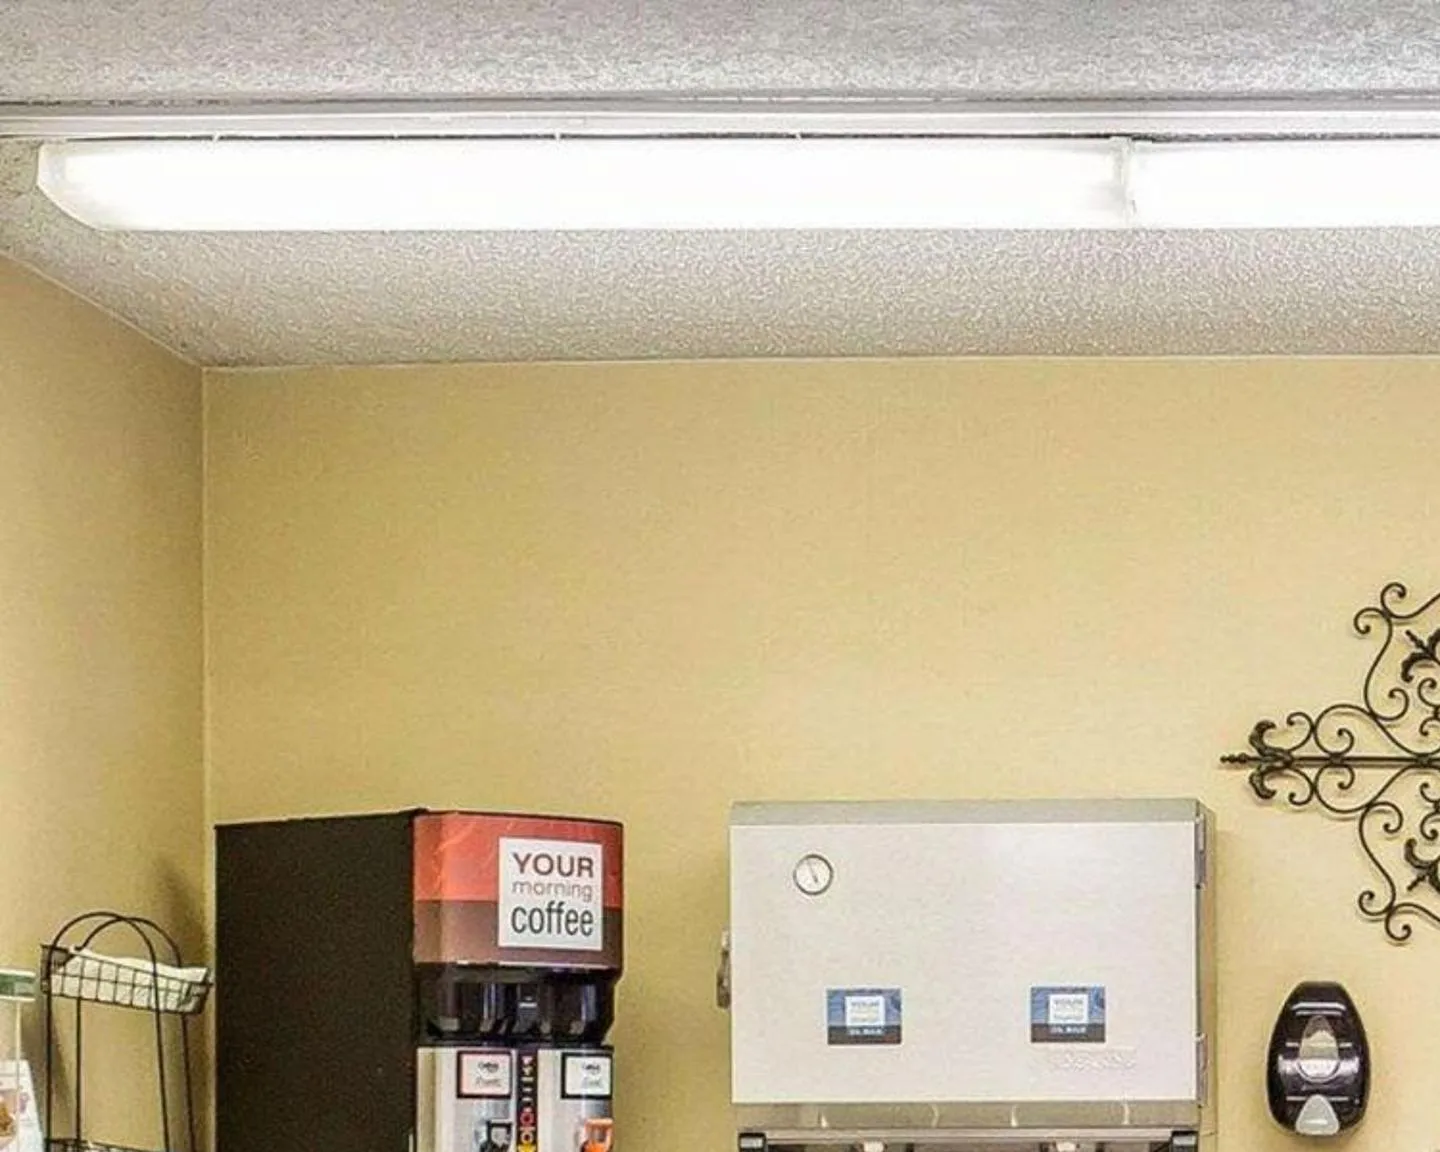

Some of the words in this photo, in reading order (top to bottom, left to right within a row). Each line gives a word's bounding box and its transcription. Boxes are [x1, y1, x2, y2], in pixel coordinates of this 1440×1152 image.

[512, 852, 594, 878] YOUR
[511, 880, 594, 902] morning
[510, 901, 594, 936] coffee
